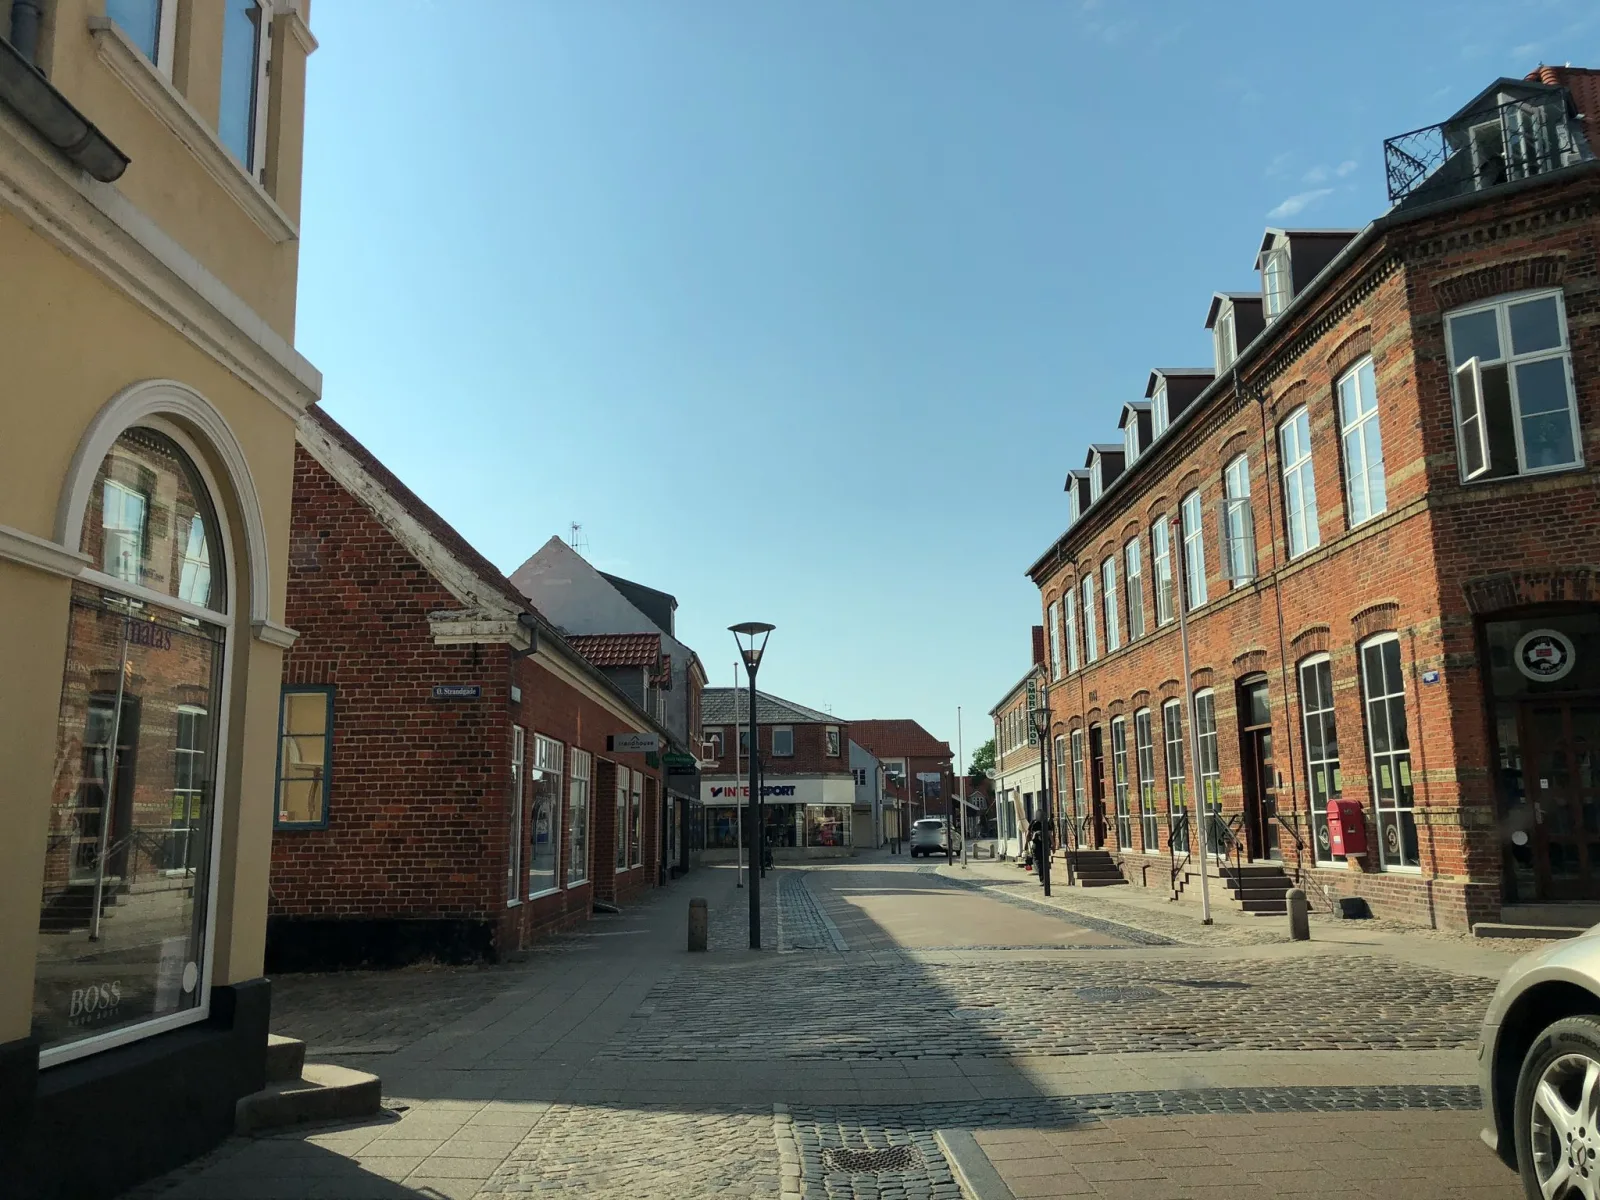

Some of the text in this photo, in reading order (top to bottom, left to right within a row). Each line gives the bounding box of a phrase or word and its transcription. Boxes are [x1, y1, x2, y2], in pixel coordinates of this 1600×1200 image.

[125, 618, 172, 651] matas
[444, 687, 476, 696] Strandgade
[724, 785, 796, 797] INTESPORT
[69, 980, 121, 1017] BOSS
